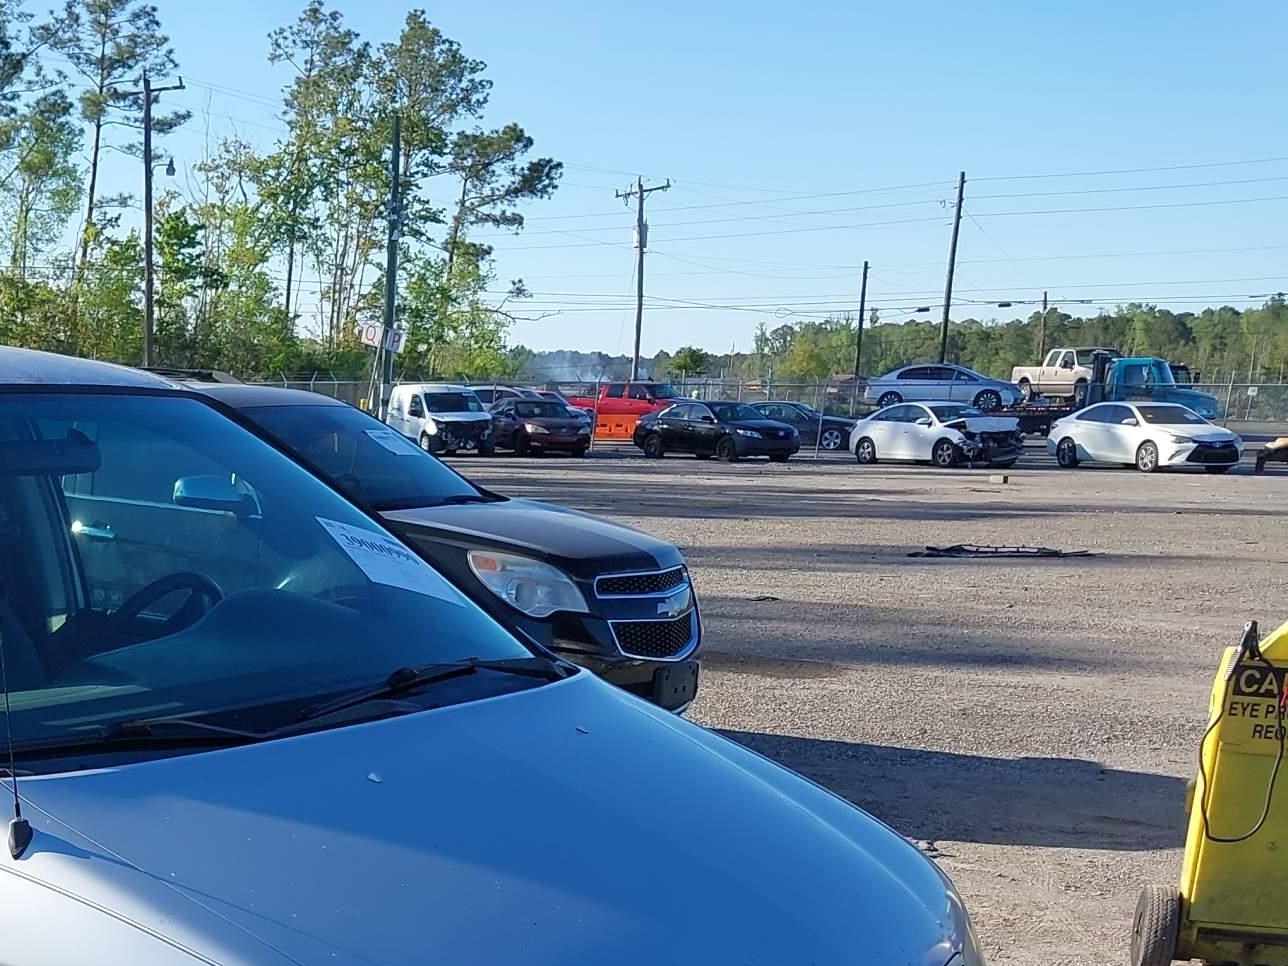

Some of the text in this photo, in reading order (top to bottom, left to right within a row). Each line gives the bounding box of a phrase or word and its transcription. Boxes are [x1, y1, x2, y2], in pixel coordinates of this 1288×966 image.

[365, 325, 377, 345] Q
[391, 333, 401, 348] P
[1239, 669, 1288, 694] CA
[1229, 702, 1260, 717] EYE
